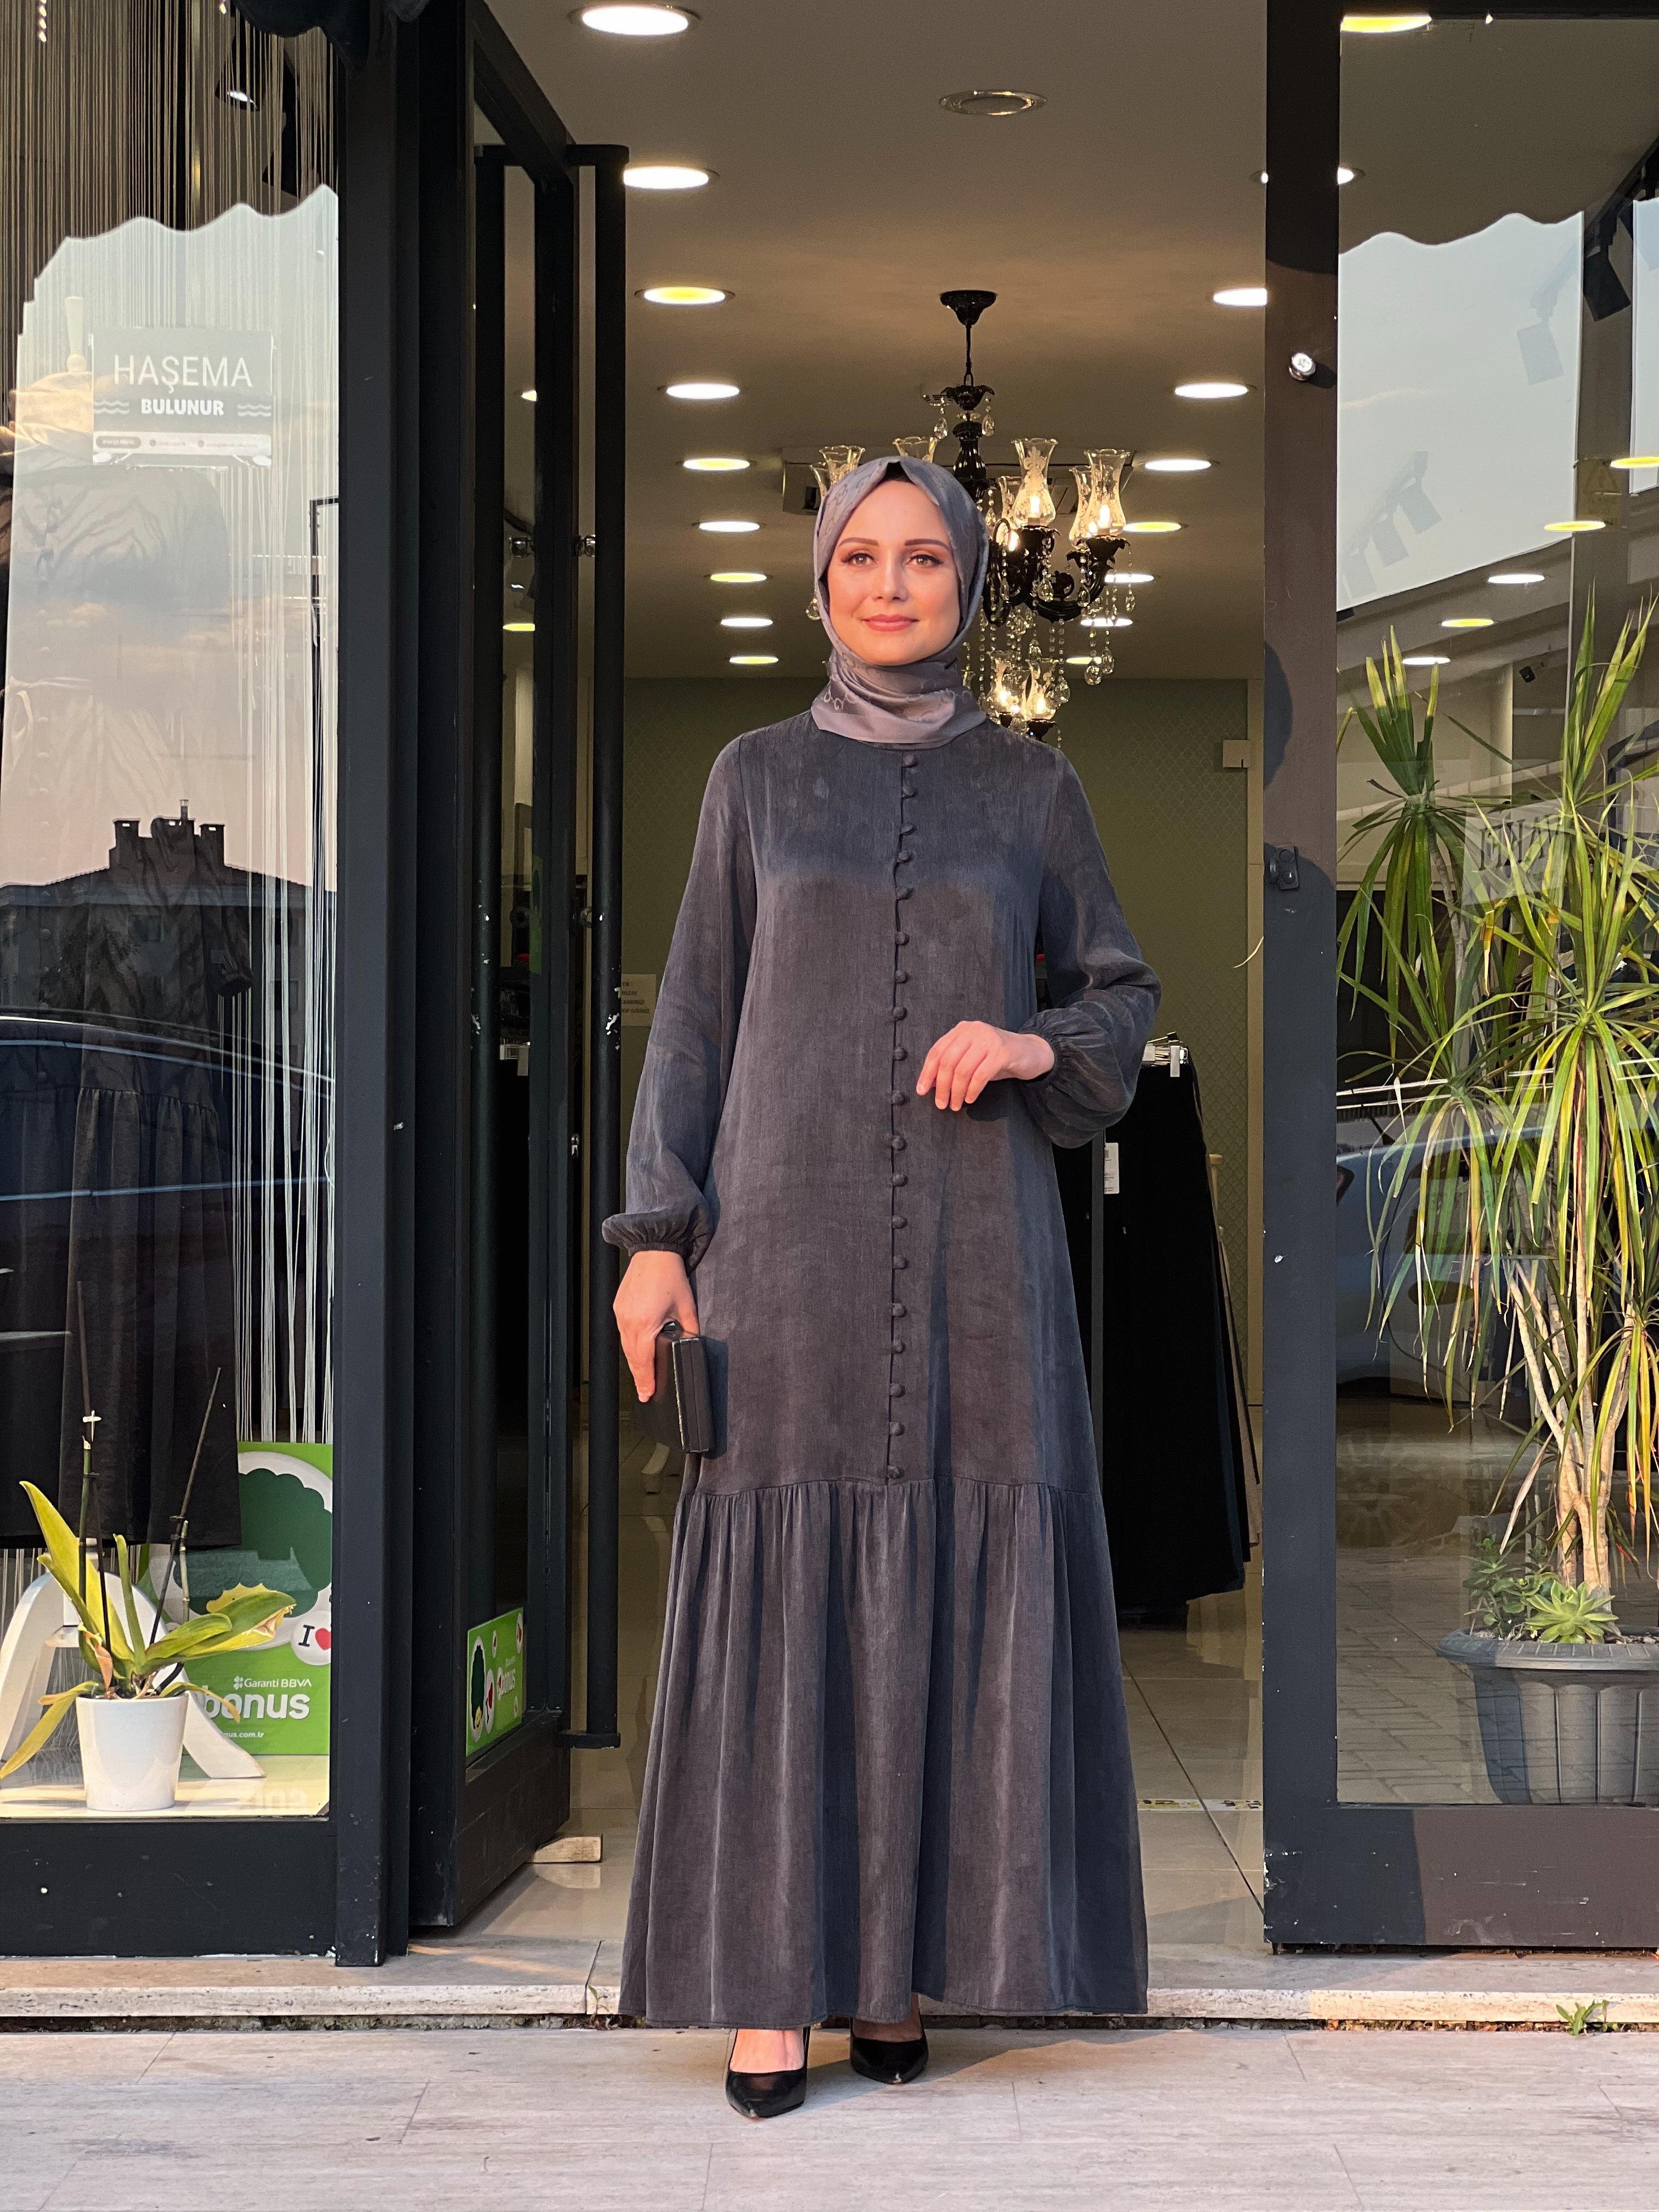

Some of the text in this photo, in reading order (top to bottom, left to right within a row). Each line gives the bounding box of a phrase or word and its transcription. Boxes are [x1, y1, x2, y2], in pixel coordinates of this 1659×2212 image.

[114, 354, 253, 394] HAŞEMA
[141, 398, 224, 416] BULUNUR
[244, 1678, 312, 1688] Garanti BBVA
[202, 1685, 311, 1720] bonus
